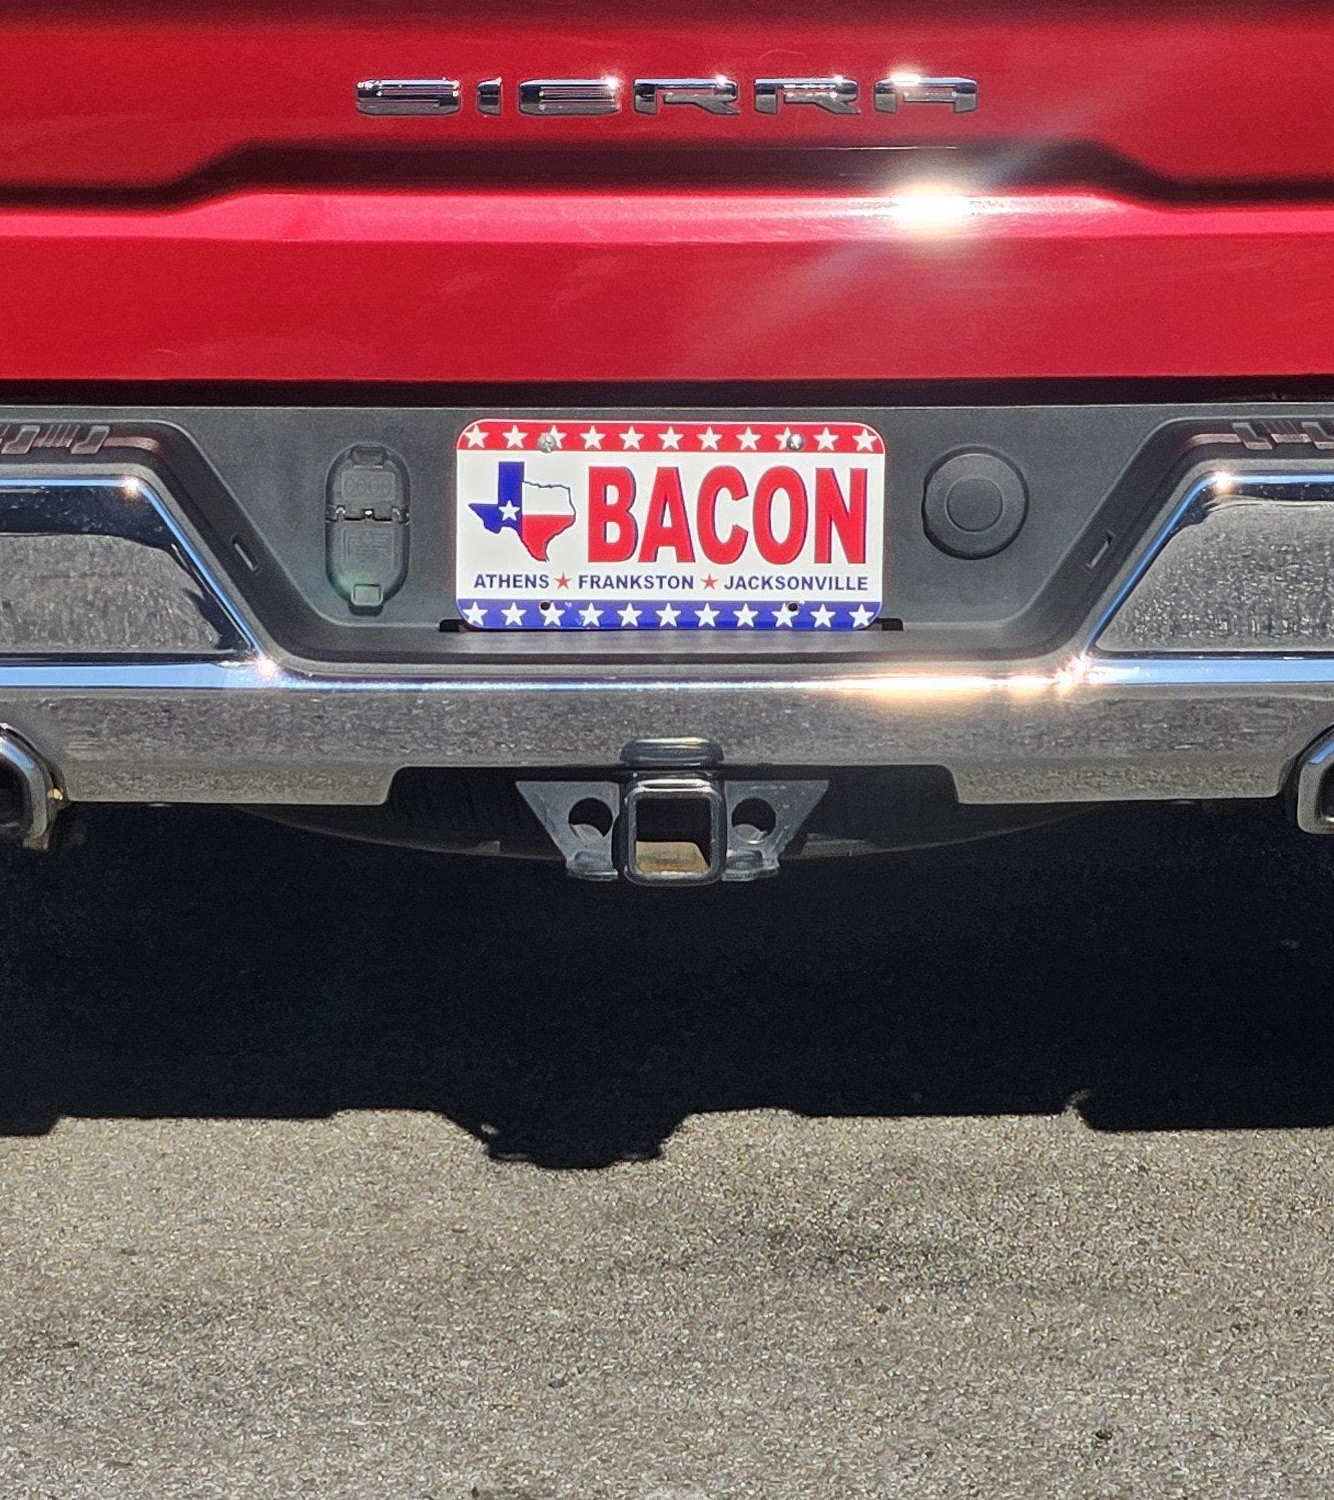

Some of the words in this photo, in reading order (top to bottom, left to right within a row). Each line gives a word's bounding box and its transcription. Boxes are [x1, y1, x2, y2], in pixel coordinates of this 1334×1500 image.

[355, 76, 979, 116] SIERRA
[587, 465, 868, 565] BACON
[473, 573, 550, 590] ATHENS
[578, 574, 695, 591] FRANKSTON
[723, 575, 869, 592] JACKSONVILLE
